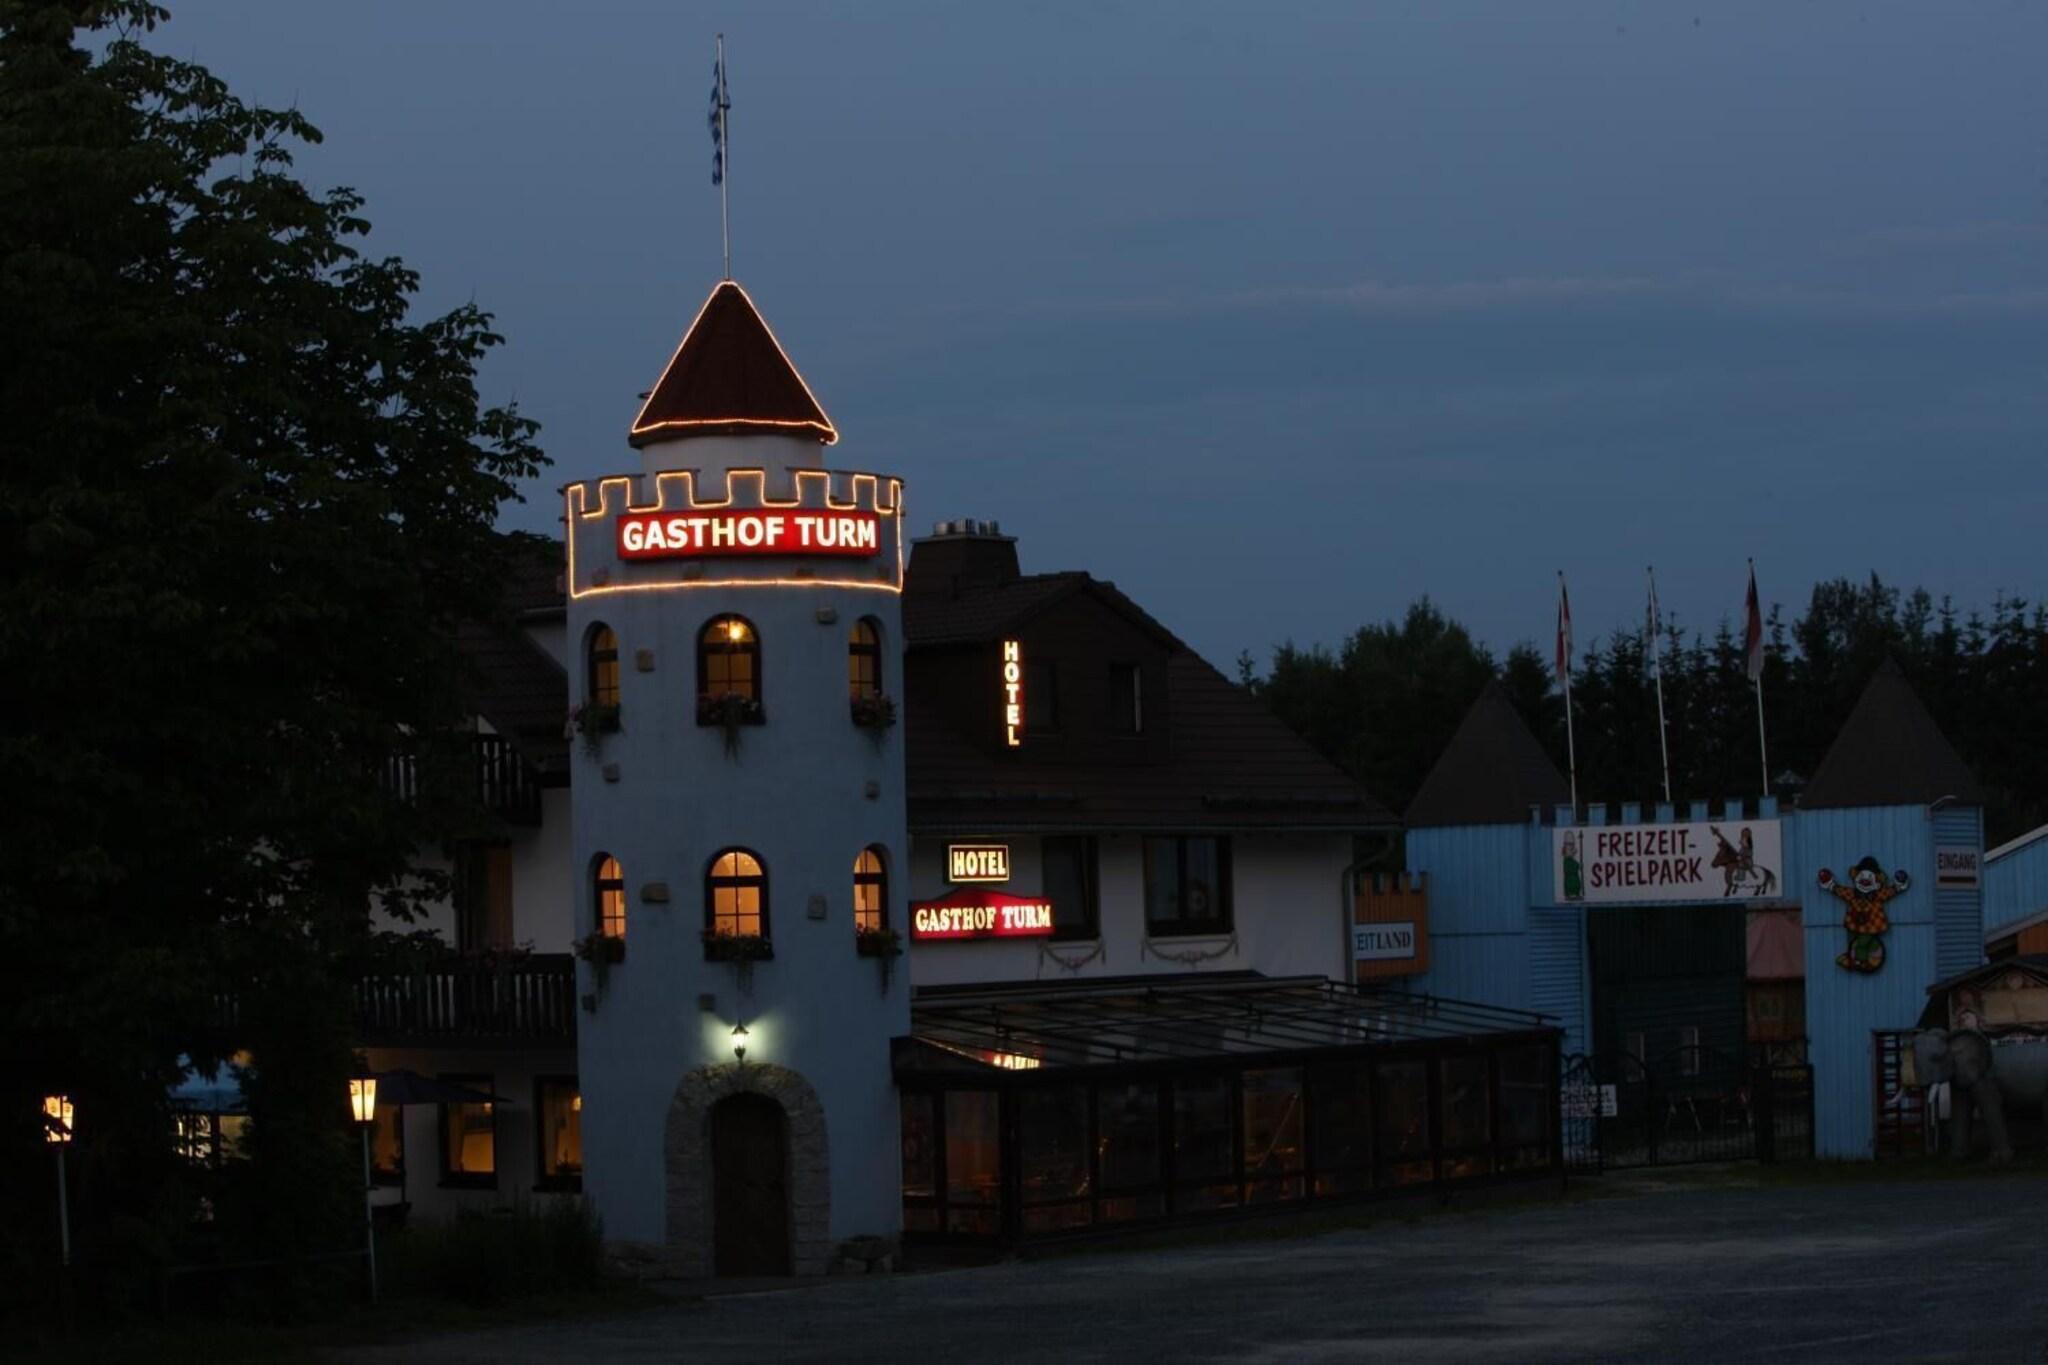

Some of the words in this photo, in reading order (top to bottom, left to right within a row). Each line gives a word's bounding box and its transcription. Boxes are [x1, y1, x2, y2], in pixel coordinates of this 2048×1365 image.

[622, 516, 784, 551] GASTHOF
[794, 517, 876, 549] TURM
[1003, 640, 1021, 746] HOTEL
[1598, 829, 1696, 857] FREIZEIT-
[953, 851, 1007, 876] HOTEL
[1591, 856, 1703, 887] SPIELPARK
[915, 906, 997, 932] GASTHOF
[1001, 904, 1052, 929] TURM
